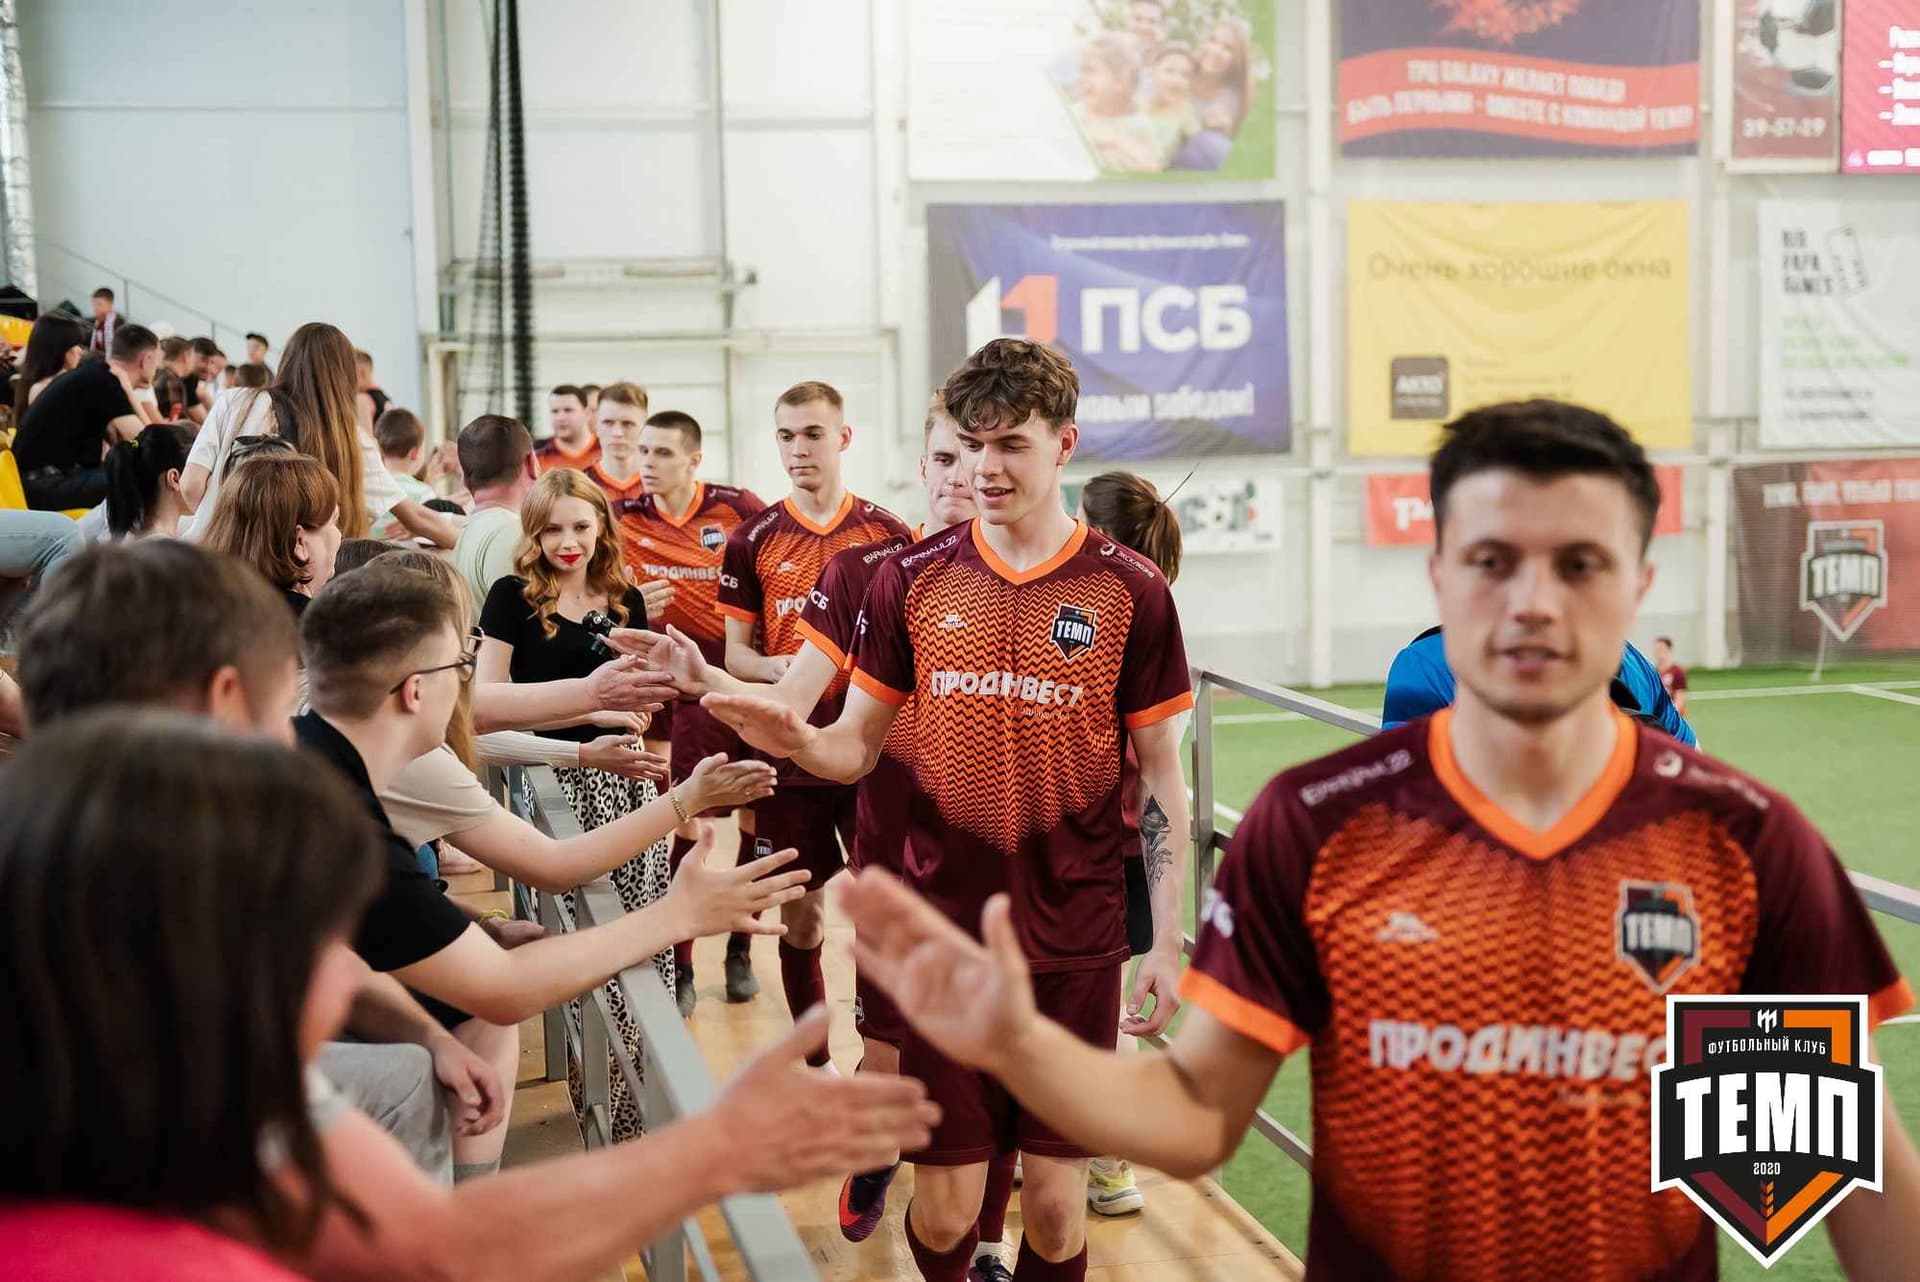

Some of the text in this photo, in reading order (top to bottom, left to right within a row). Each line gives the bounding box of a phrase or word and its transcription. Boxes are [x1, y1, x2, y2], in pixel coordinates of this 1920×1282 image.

[1080, 284, 1253, 355] ПСБ
[718, 573, 739, 590] СБ
[1810, 552, 1879, 599] ТЕМП
[808, 586, 830, 611] СБ
[1056, 620, 1093, 645] ТЕМП
[1625, 913, 1692, 955] ТЕМП
